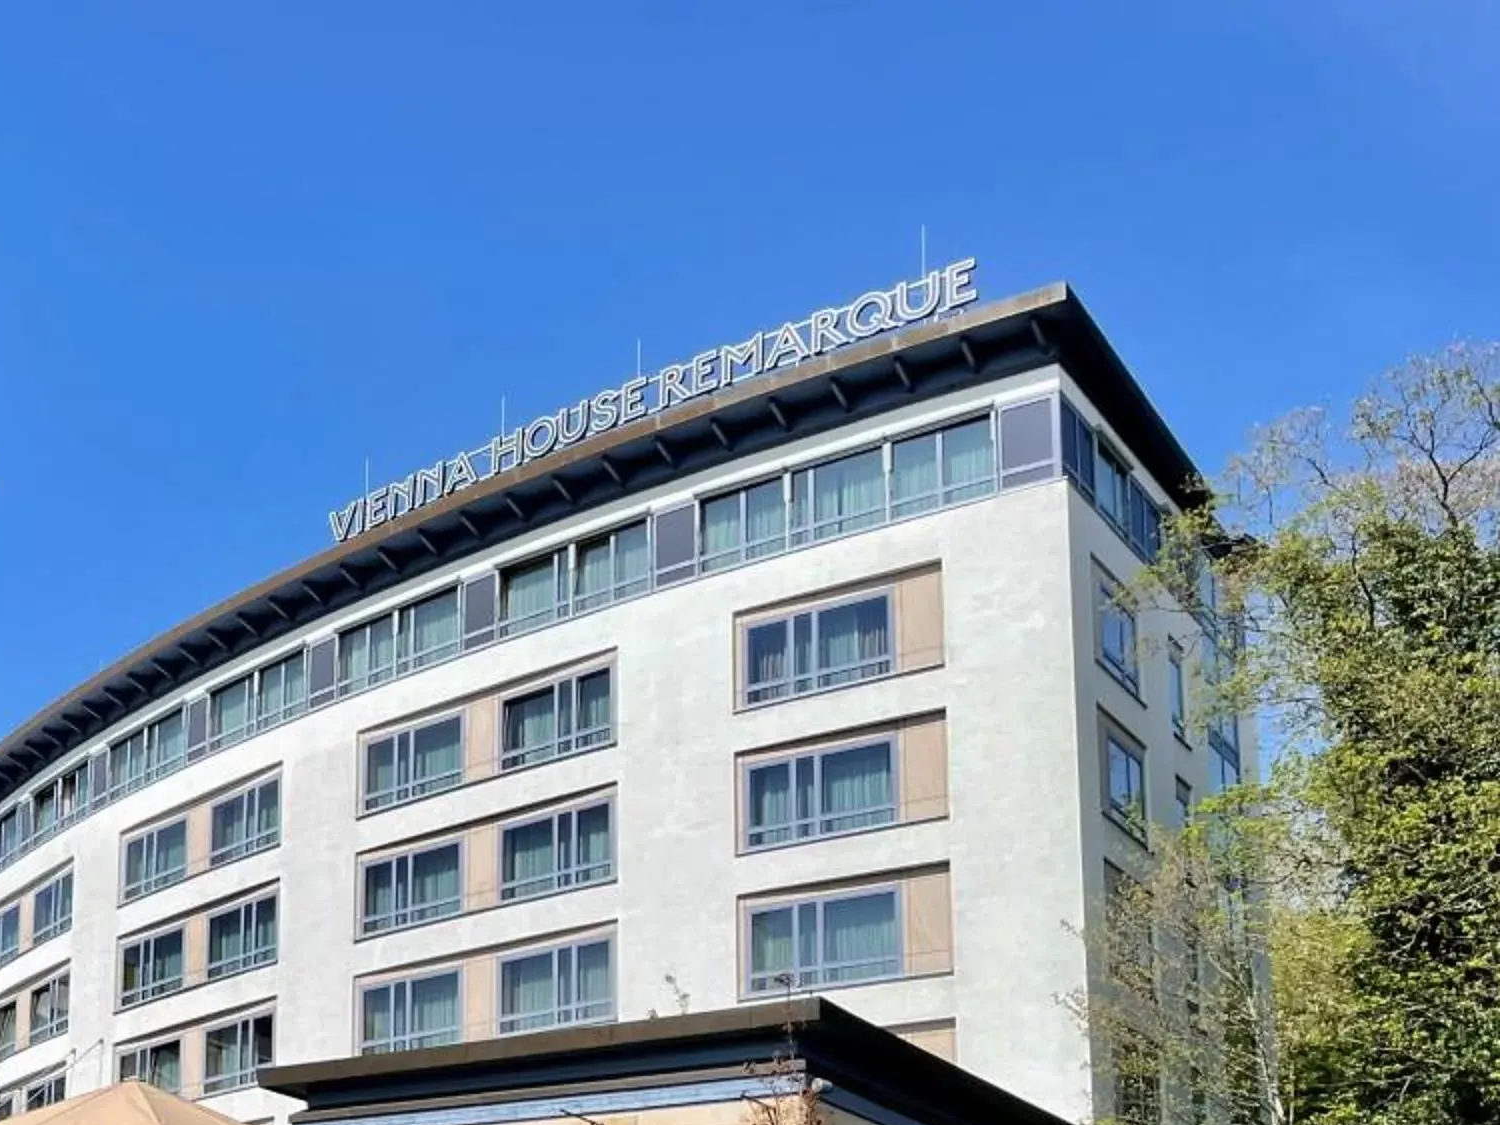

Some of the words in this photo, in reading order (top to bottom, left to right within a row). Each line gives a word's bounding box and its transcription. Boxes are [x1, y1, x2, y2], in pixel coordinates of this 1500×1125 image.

[329, 451, 477, 542] VIENNA
[491, 376, 647, 474] HOUSE
[658, 256, 978, 407] REMARQUE
